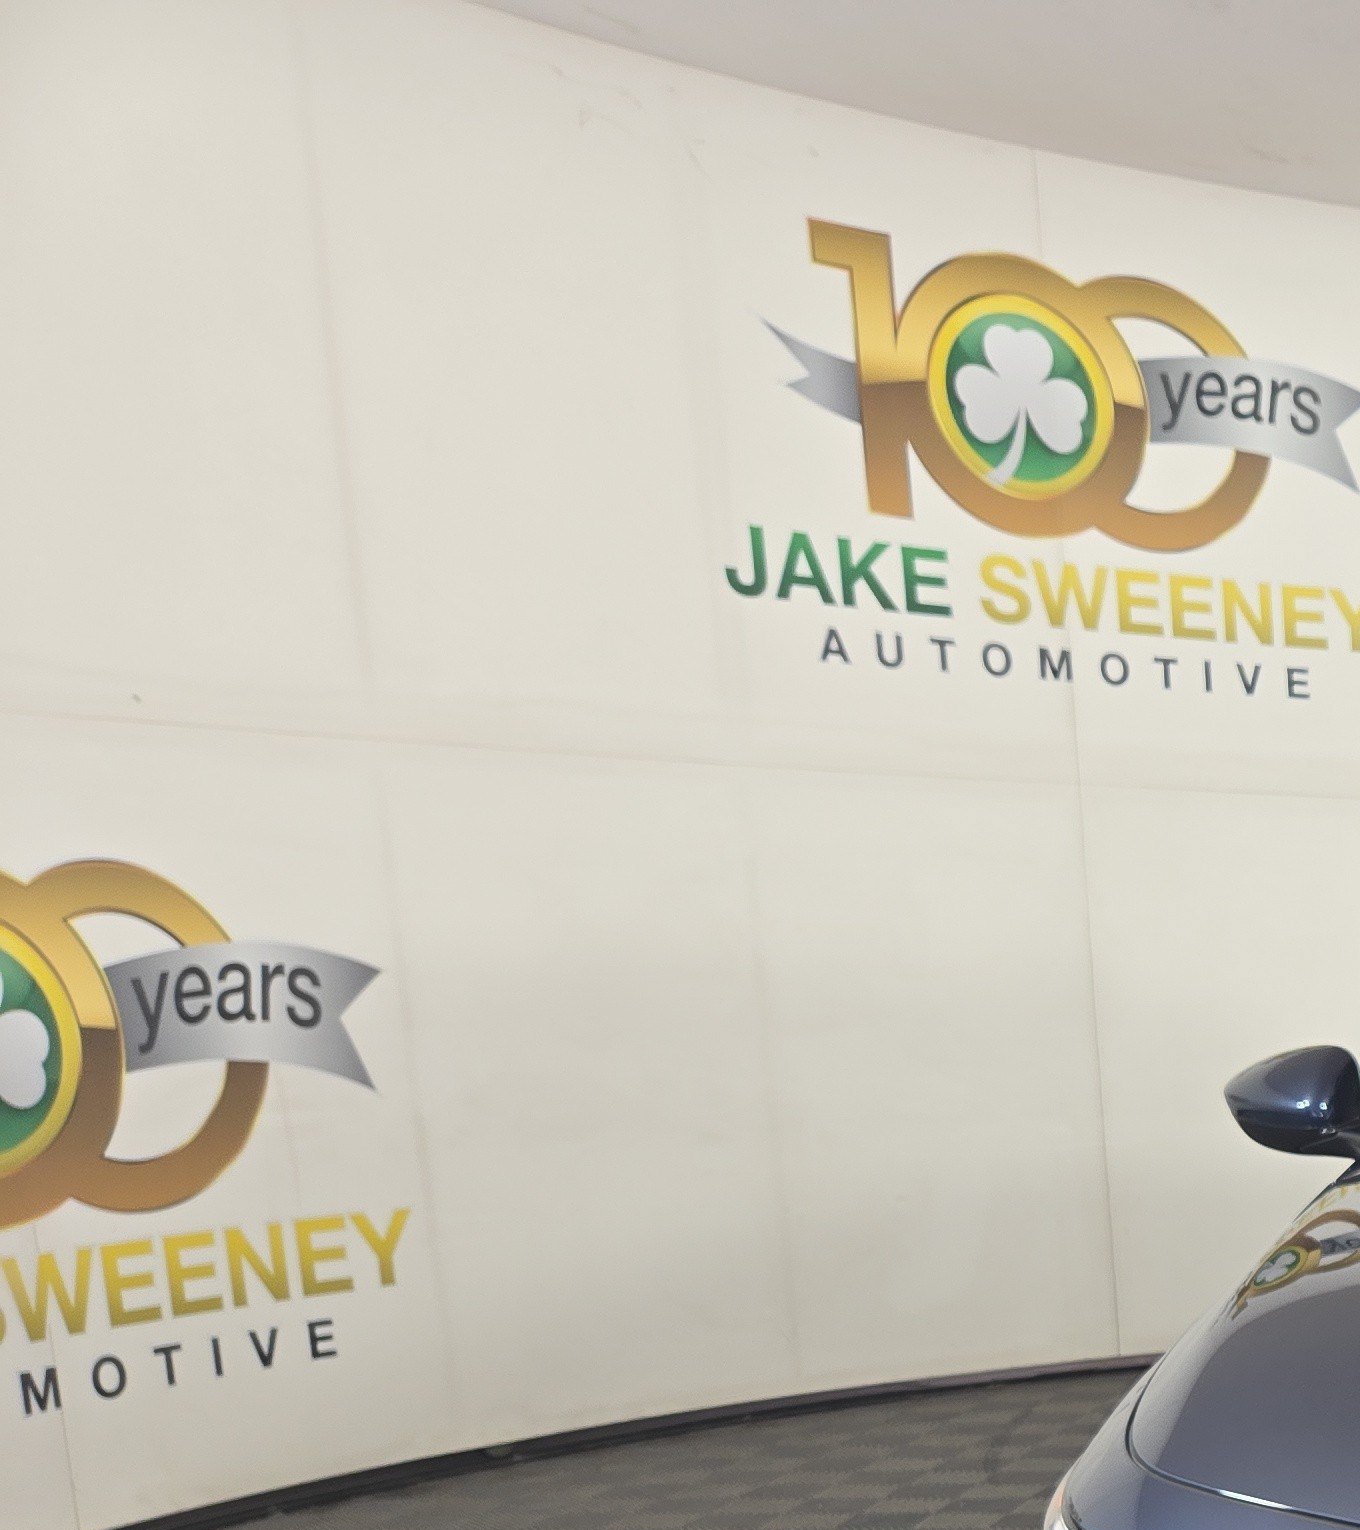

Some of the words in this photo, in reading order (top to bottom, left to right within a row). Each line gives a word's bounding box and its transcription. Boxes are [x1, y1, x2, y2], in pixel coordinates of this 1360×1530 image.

[1159, 367, 1323, 436] years
[725, 524, 953, 617] JAKE
[820, 628, 1312, 699] AUTOMOTIVE
[130, 961, 323, 1053] years
[0, 1208, 412, 1344] WEENEY
